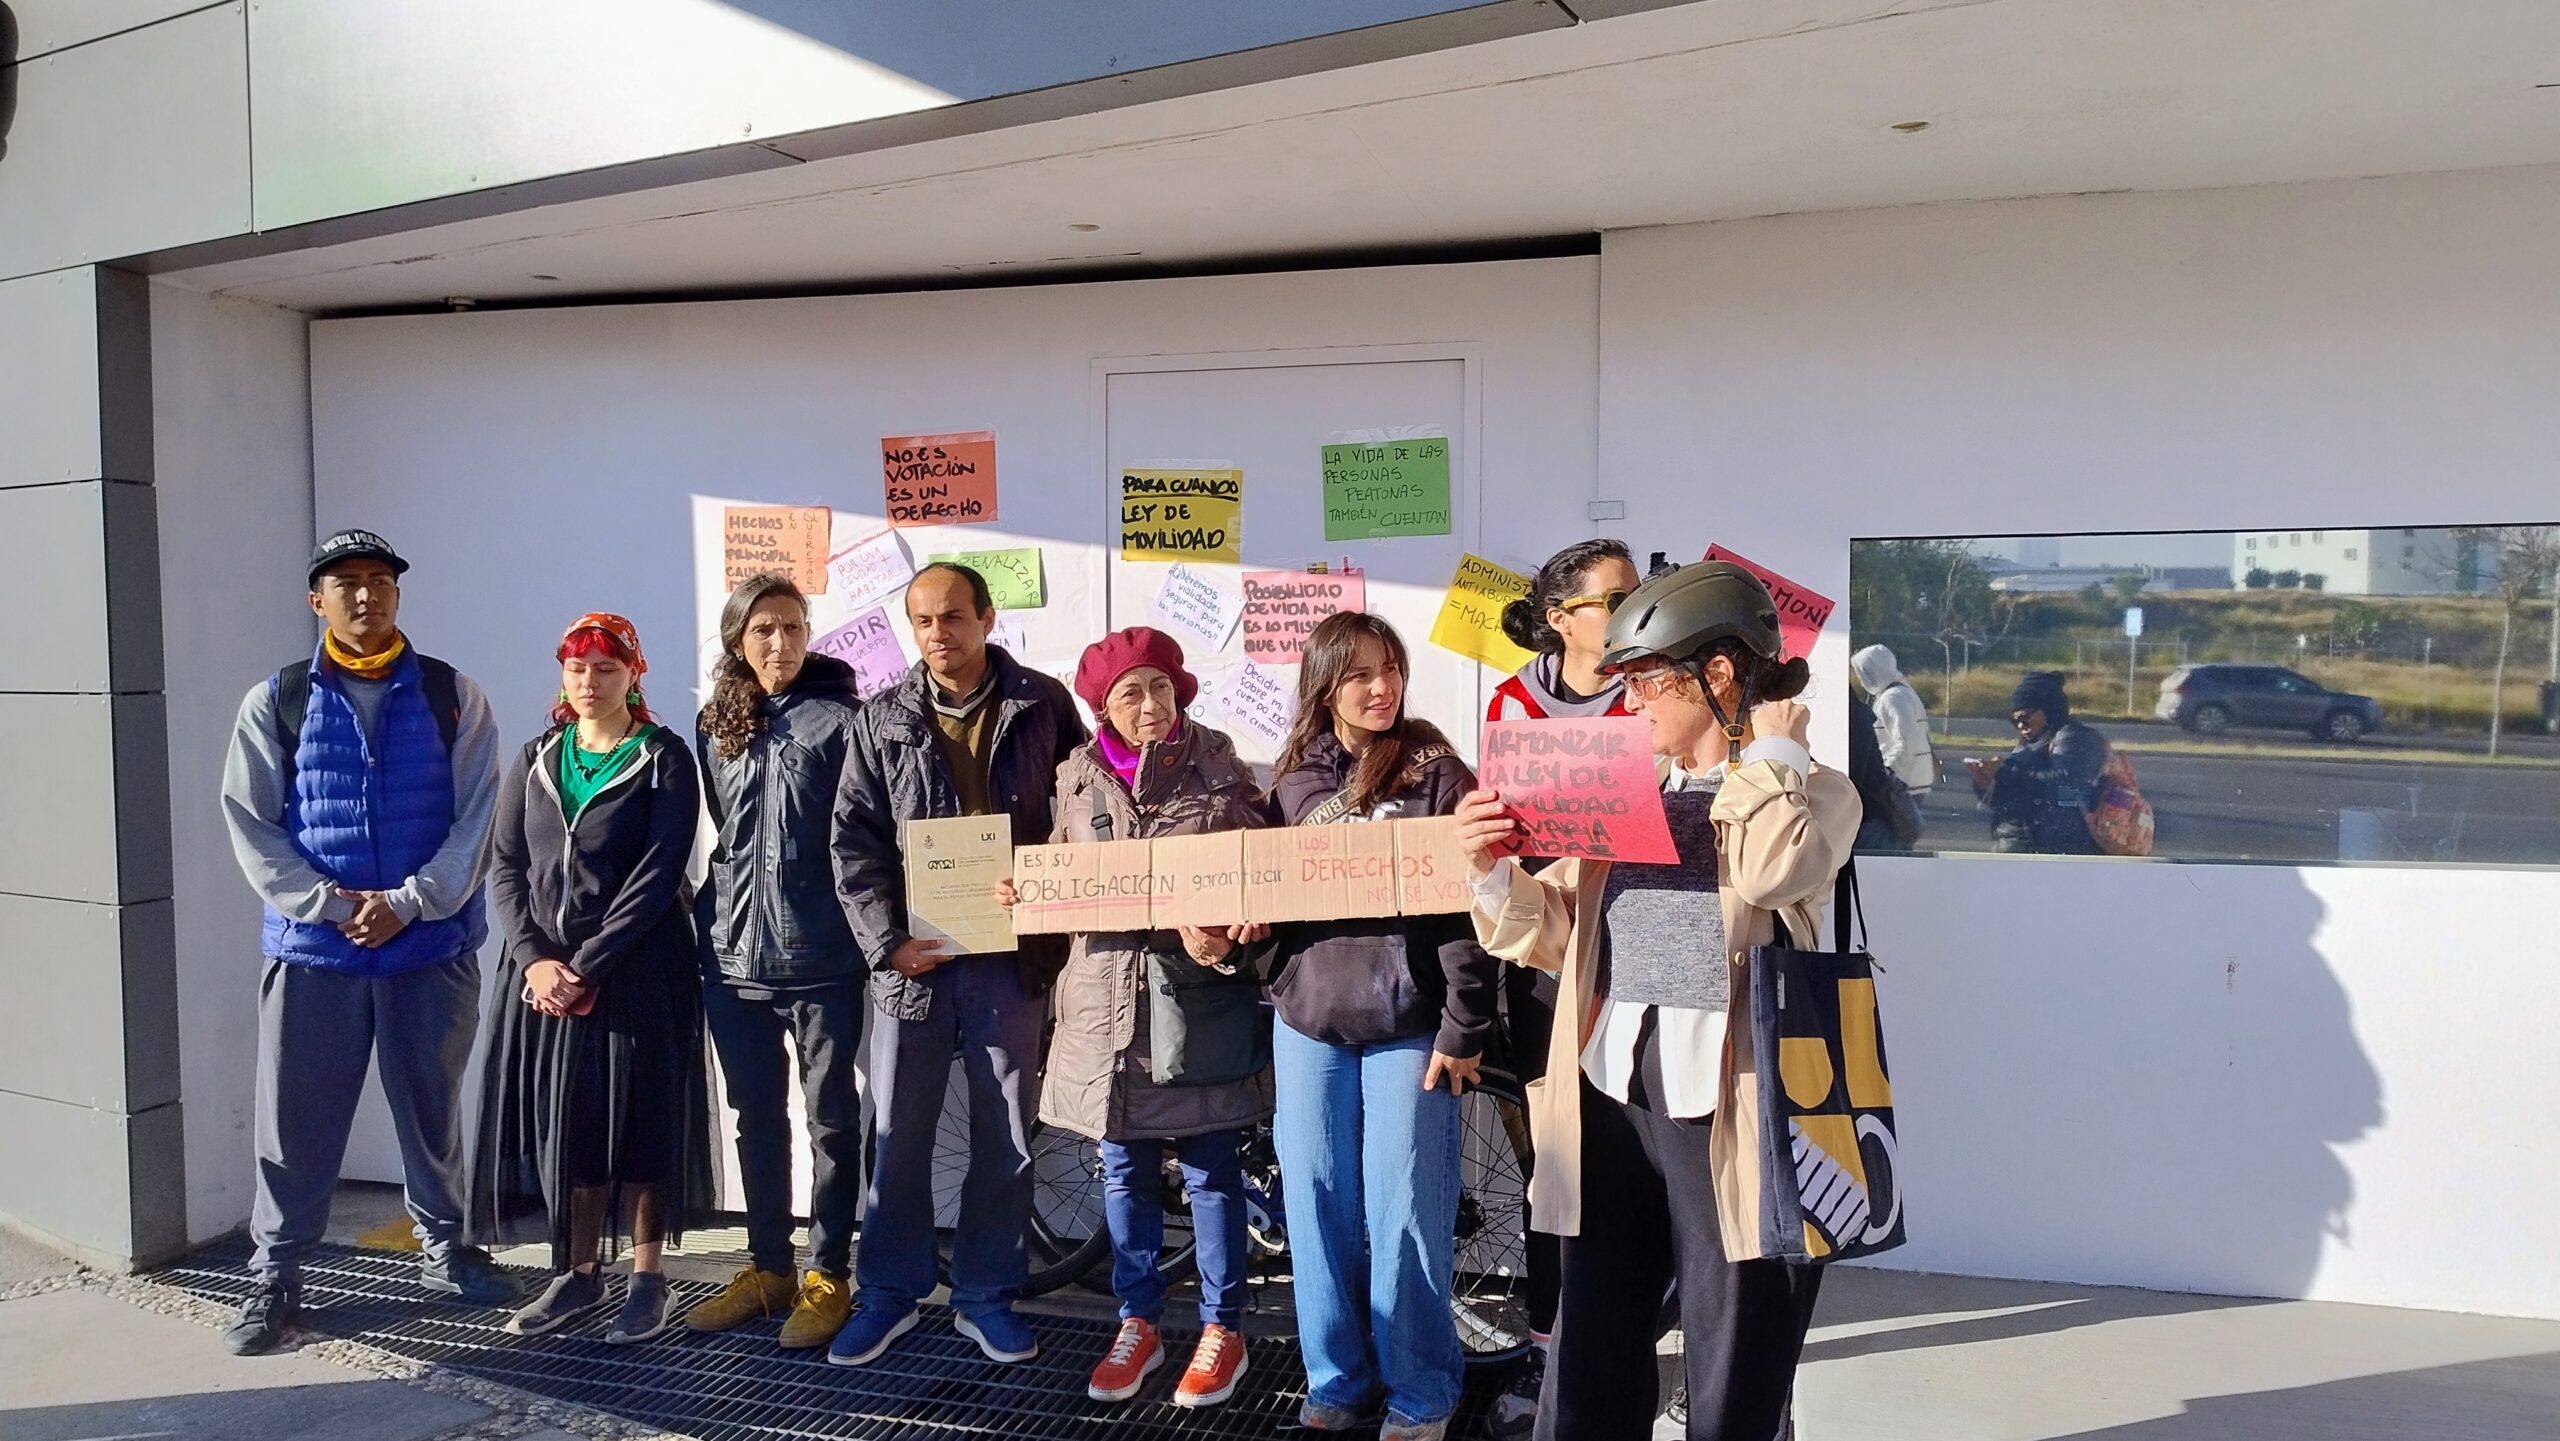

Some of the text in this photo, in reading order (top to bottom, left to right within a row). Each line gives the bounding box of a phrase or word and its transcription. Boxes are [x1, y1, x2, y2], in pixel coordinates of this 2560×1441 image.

[885, 449, 913, 465] NO
[1325, 444, 1443, 466] LA VIDA DE LAS
[886, 456, 975, 483] VOTACIÓN
[1324, 466, 1402, 484] PERSONAS
[887, 483, 947, 502] ES UN
[1122, 475, 1239, 496] PARA CUANDO
[1344, 484, 1424, 502] PEATONAS
[891, 498, 982, 523] DERECHO
[1121, 503, 1191, 524] LEY DE
[1329, 504, 1447, 526] TAMBIÉN CUENTAN
[729, 515, 784, 530] HECHOS
[726, 534, 778, 547] VIALES
[725, 548, 797, 563] PRINCIPAL
[837, 558, 859, 577] POR
[1246, 602, 1338, 616] DE VIDA NO
[1200, 611, 1225, 632] para
[1243, 620, 1263, 633] ES
[1265, 621, 1281, 633] LO
[1244, 639, 1277, 653] QUE
[1244, 663, 1282, 694] Decidir
[1236, 688, 1287, 727] cuerpo no
[1249, 716, 1279, 741] crimen
[1487, 728, 1630, 762] ARMONIZAR
[1486, 761, 1619, 792] LA LEY DE
[1023, 852, 1073, 868] ES SU
[1019, 869, 1175, 903] OBLIGACIÓN
[1302, 854, 1434, 882] DERECHOS
